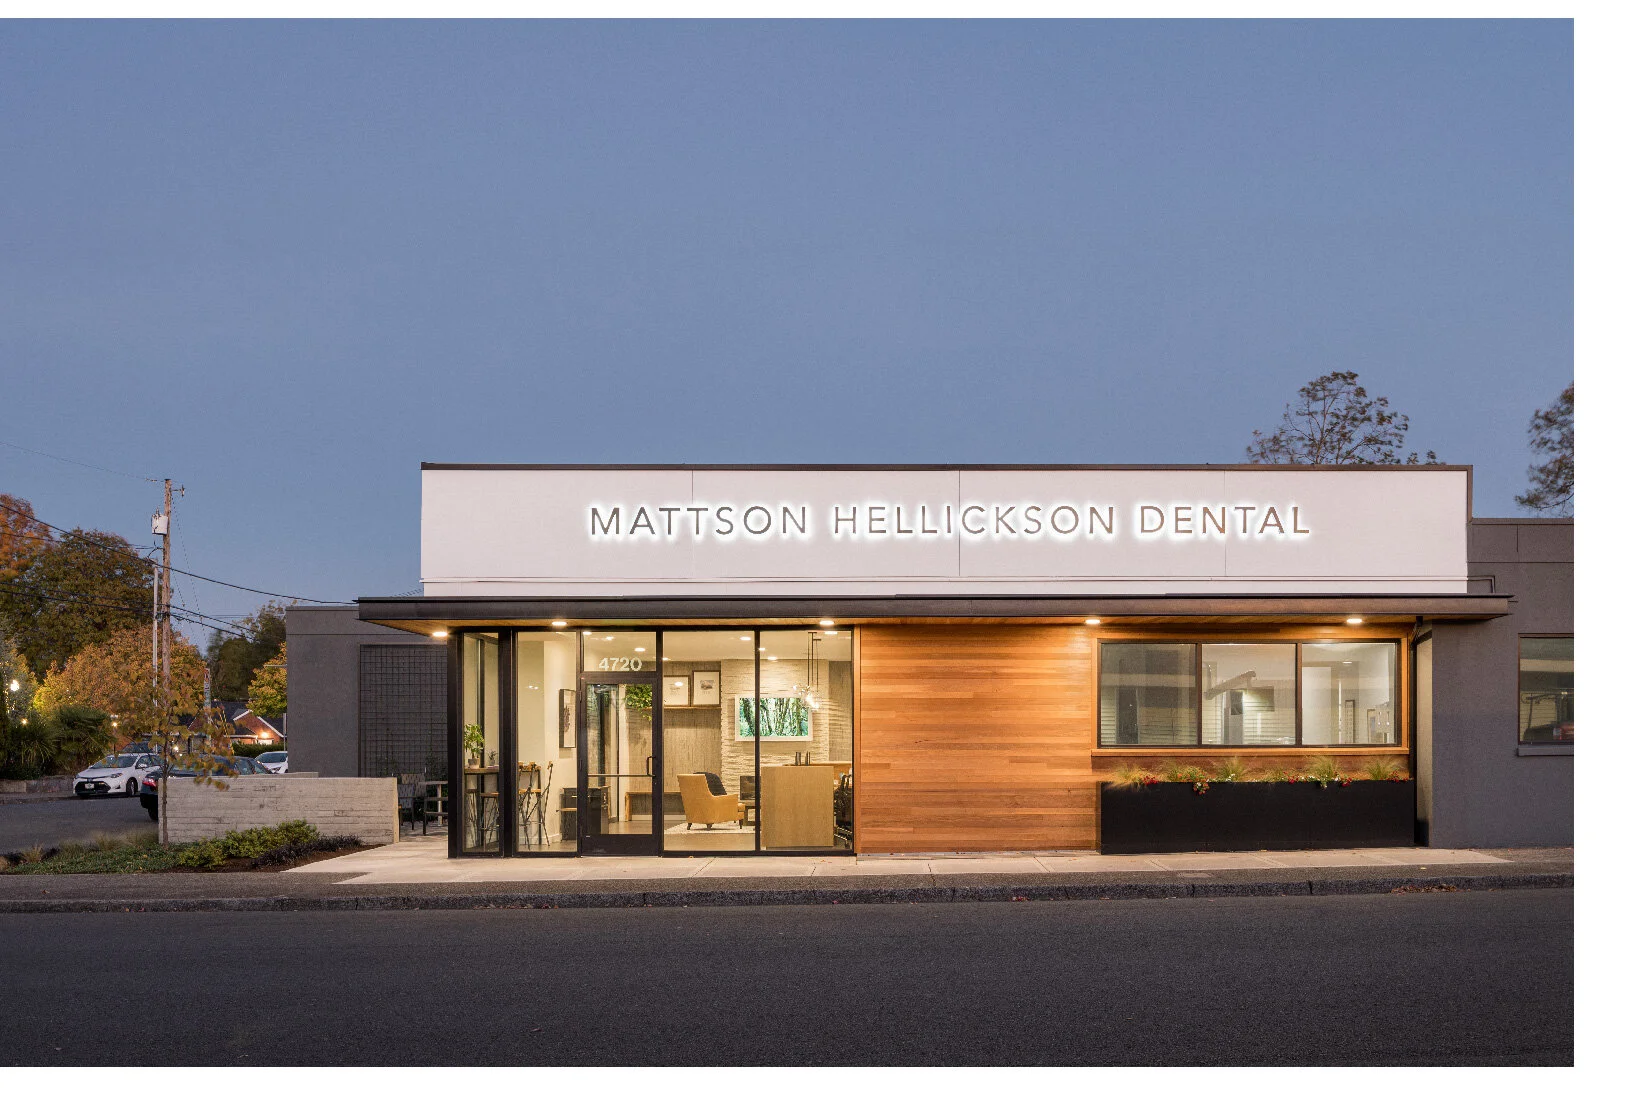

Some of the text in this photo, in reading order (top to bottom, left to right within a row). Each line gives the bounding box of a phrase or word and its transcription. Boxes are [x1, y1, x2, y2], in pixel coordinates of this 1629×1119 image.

[590, 505, 1310, 535] MATTSON HELLICKSON DENTAL
[598, 656, 643, 672] 4720
